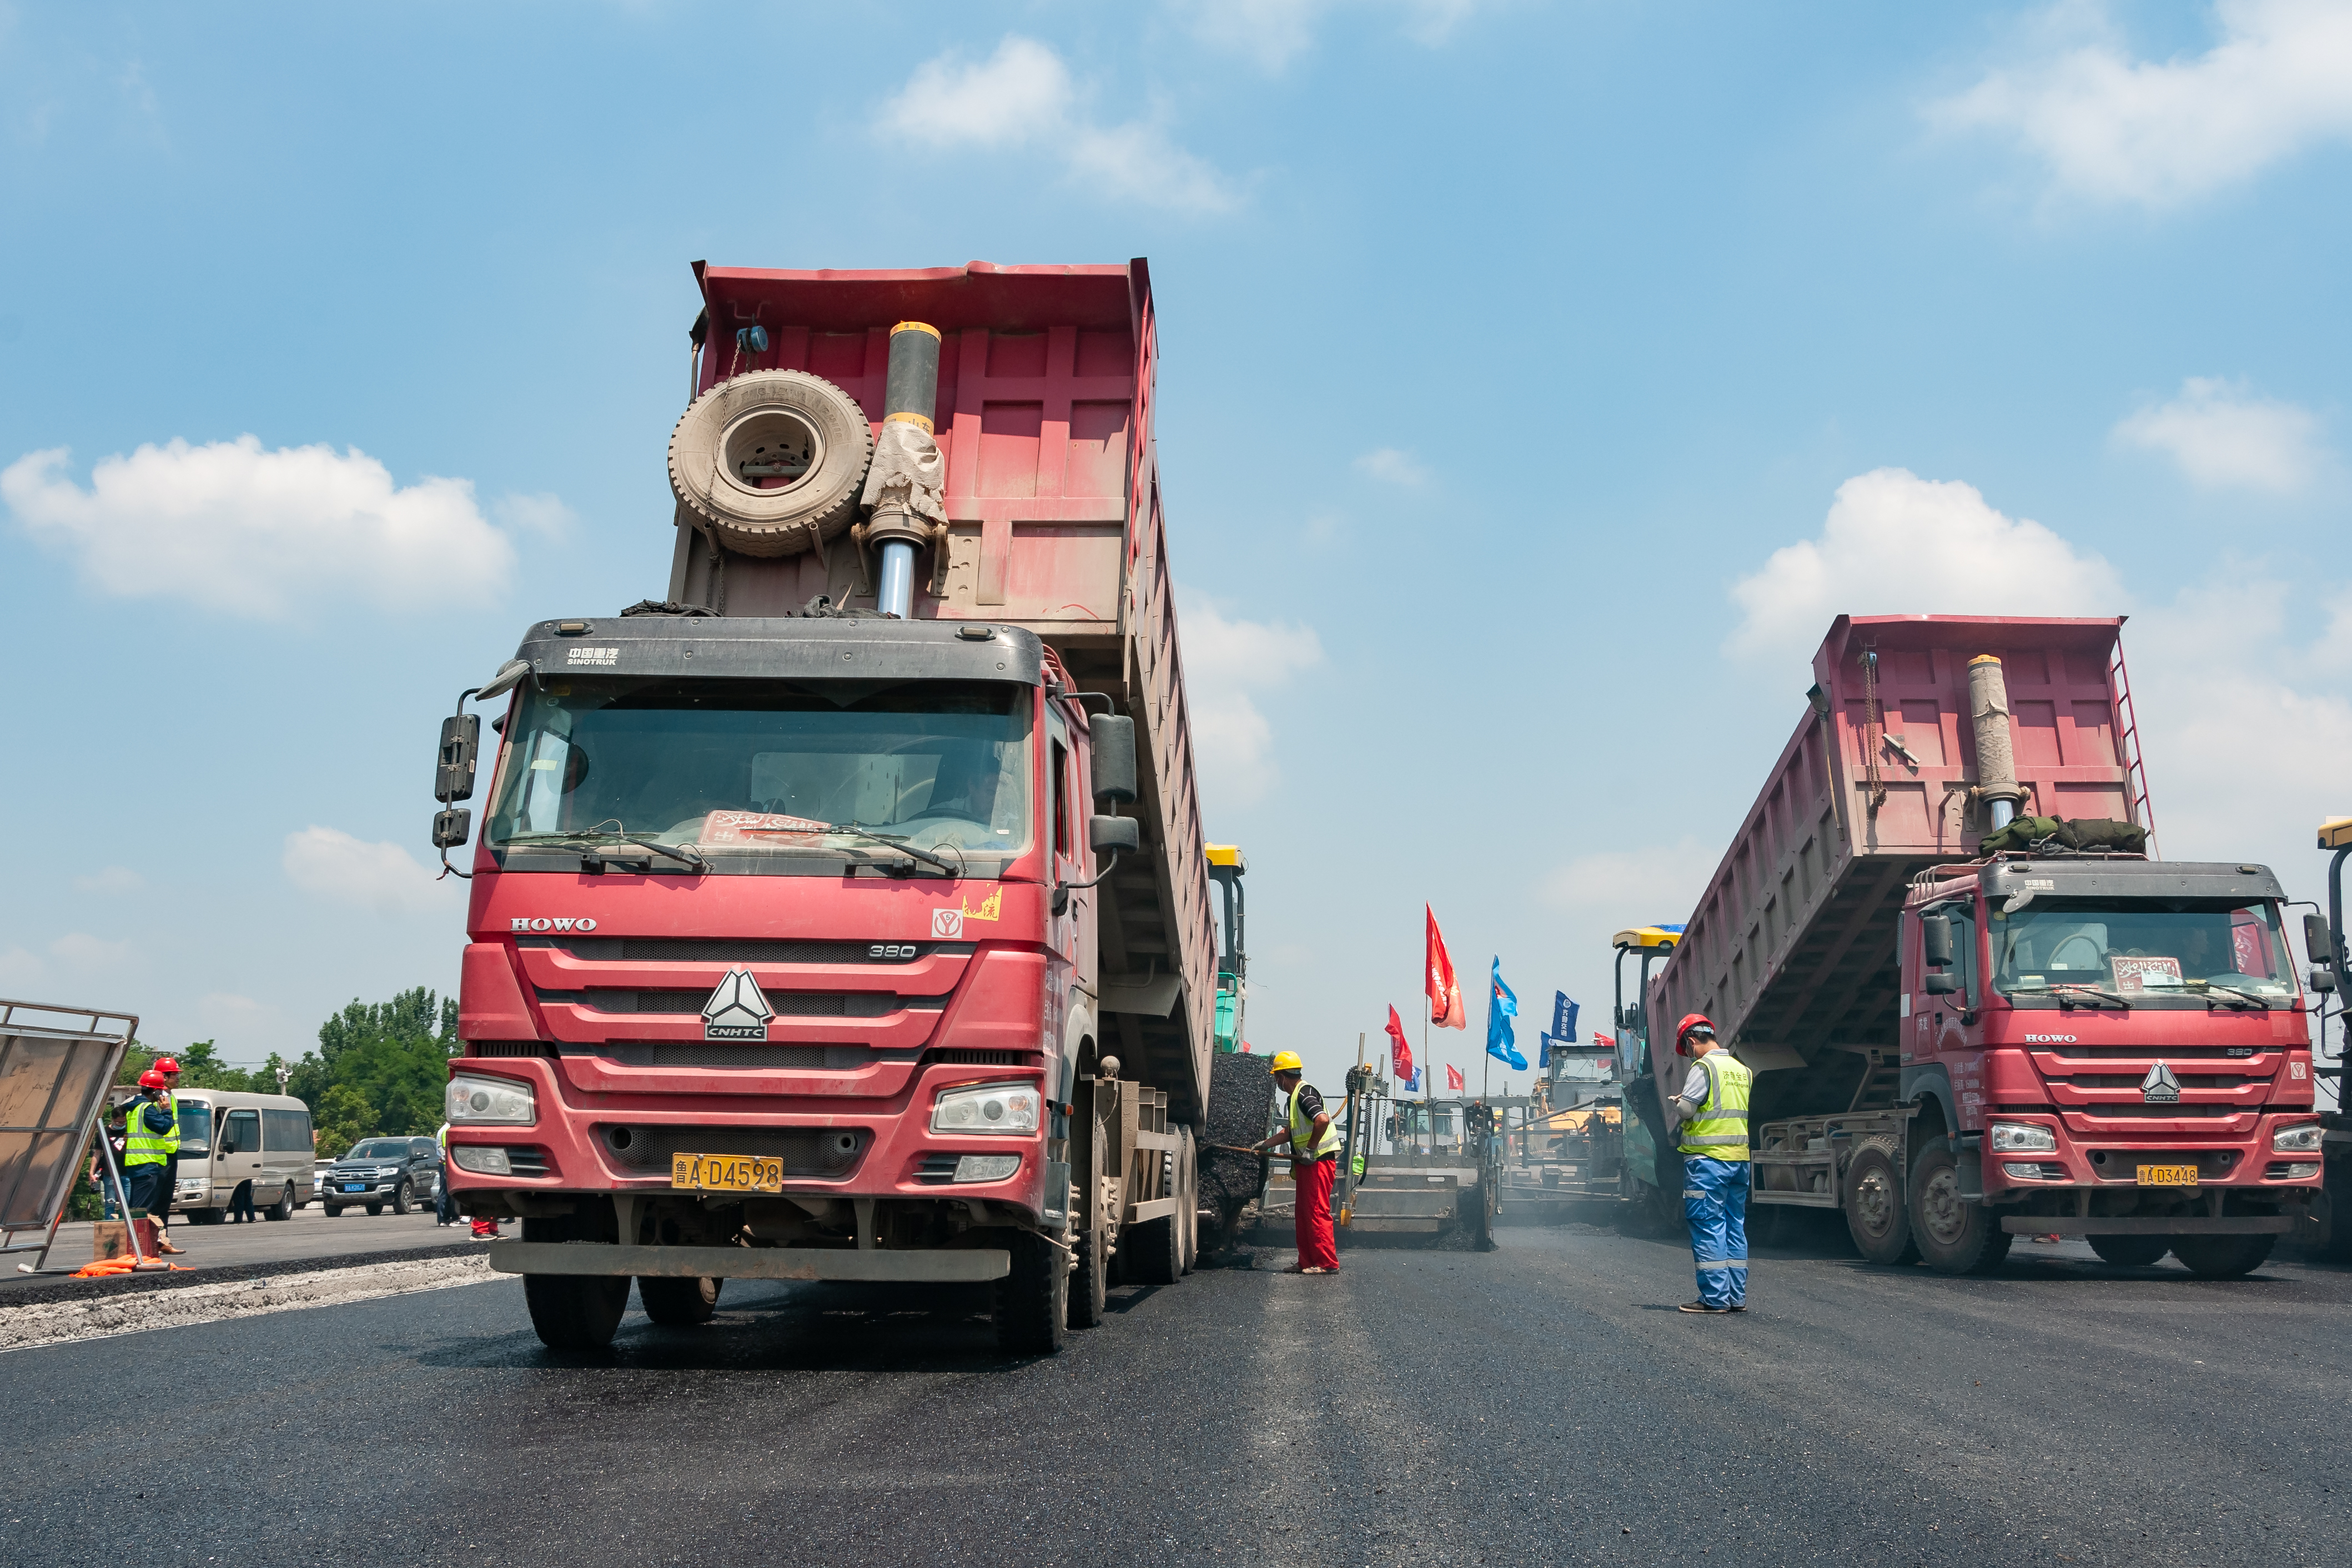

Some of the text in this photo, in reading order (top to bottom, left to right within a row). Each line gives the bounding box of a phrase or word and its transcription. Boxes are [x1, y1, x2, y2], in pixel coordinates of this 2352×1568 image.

[569, 647, 619, 659] 中国重汽
[510, 918, 597, 931] HOWO
[869, 946, 916, 957] 380
[708, 1028, 763, 1037] CNHTC
[2024, 1034, 2077, 1043] HOWO
